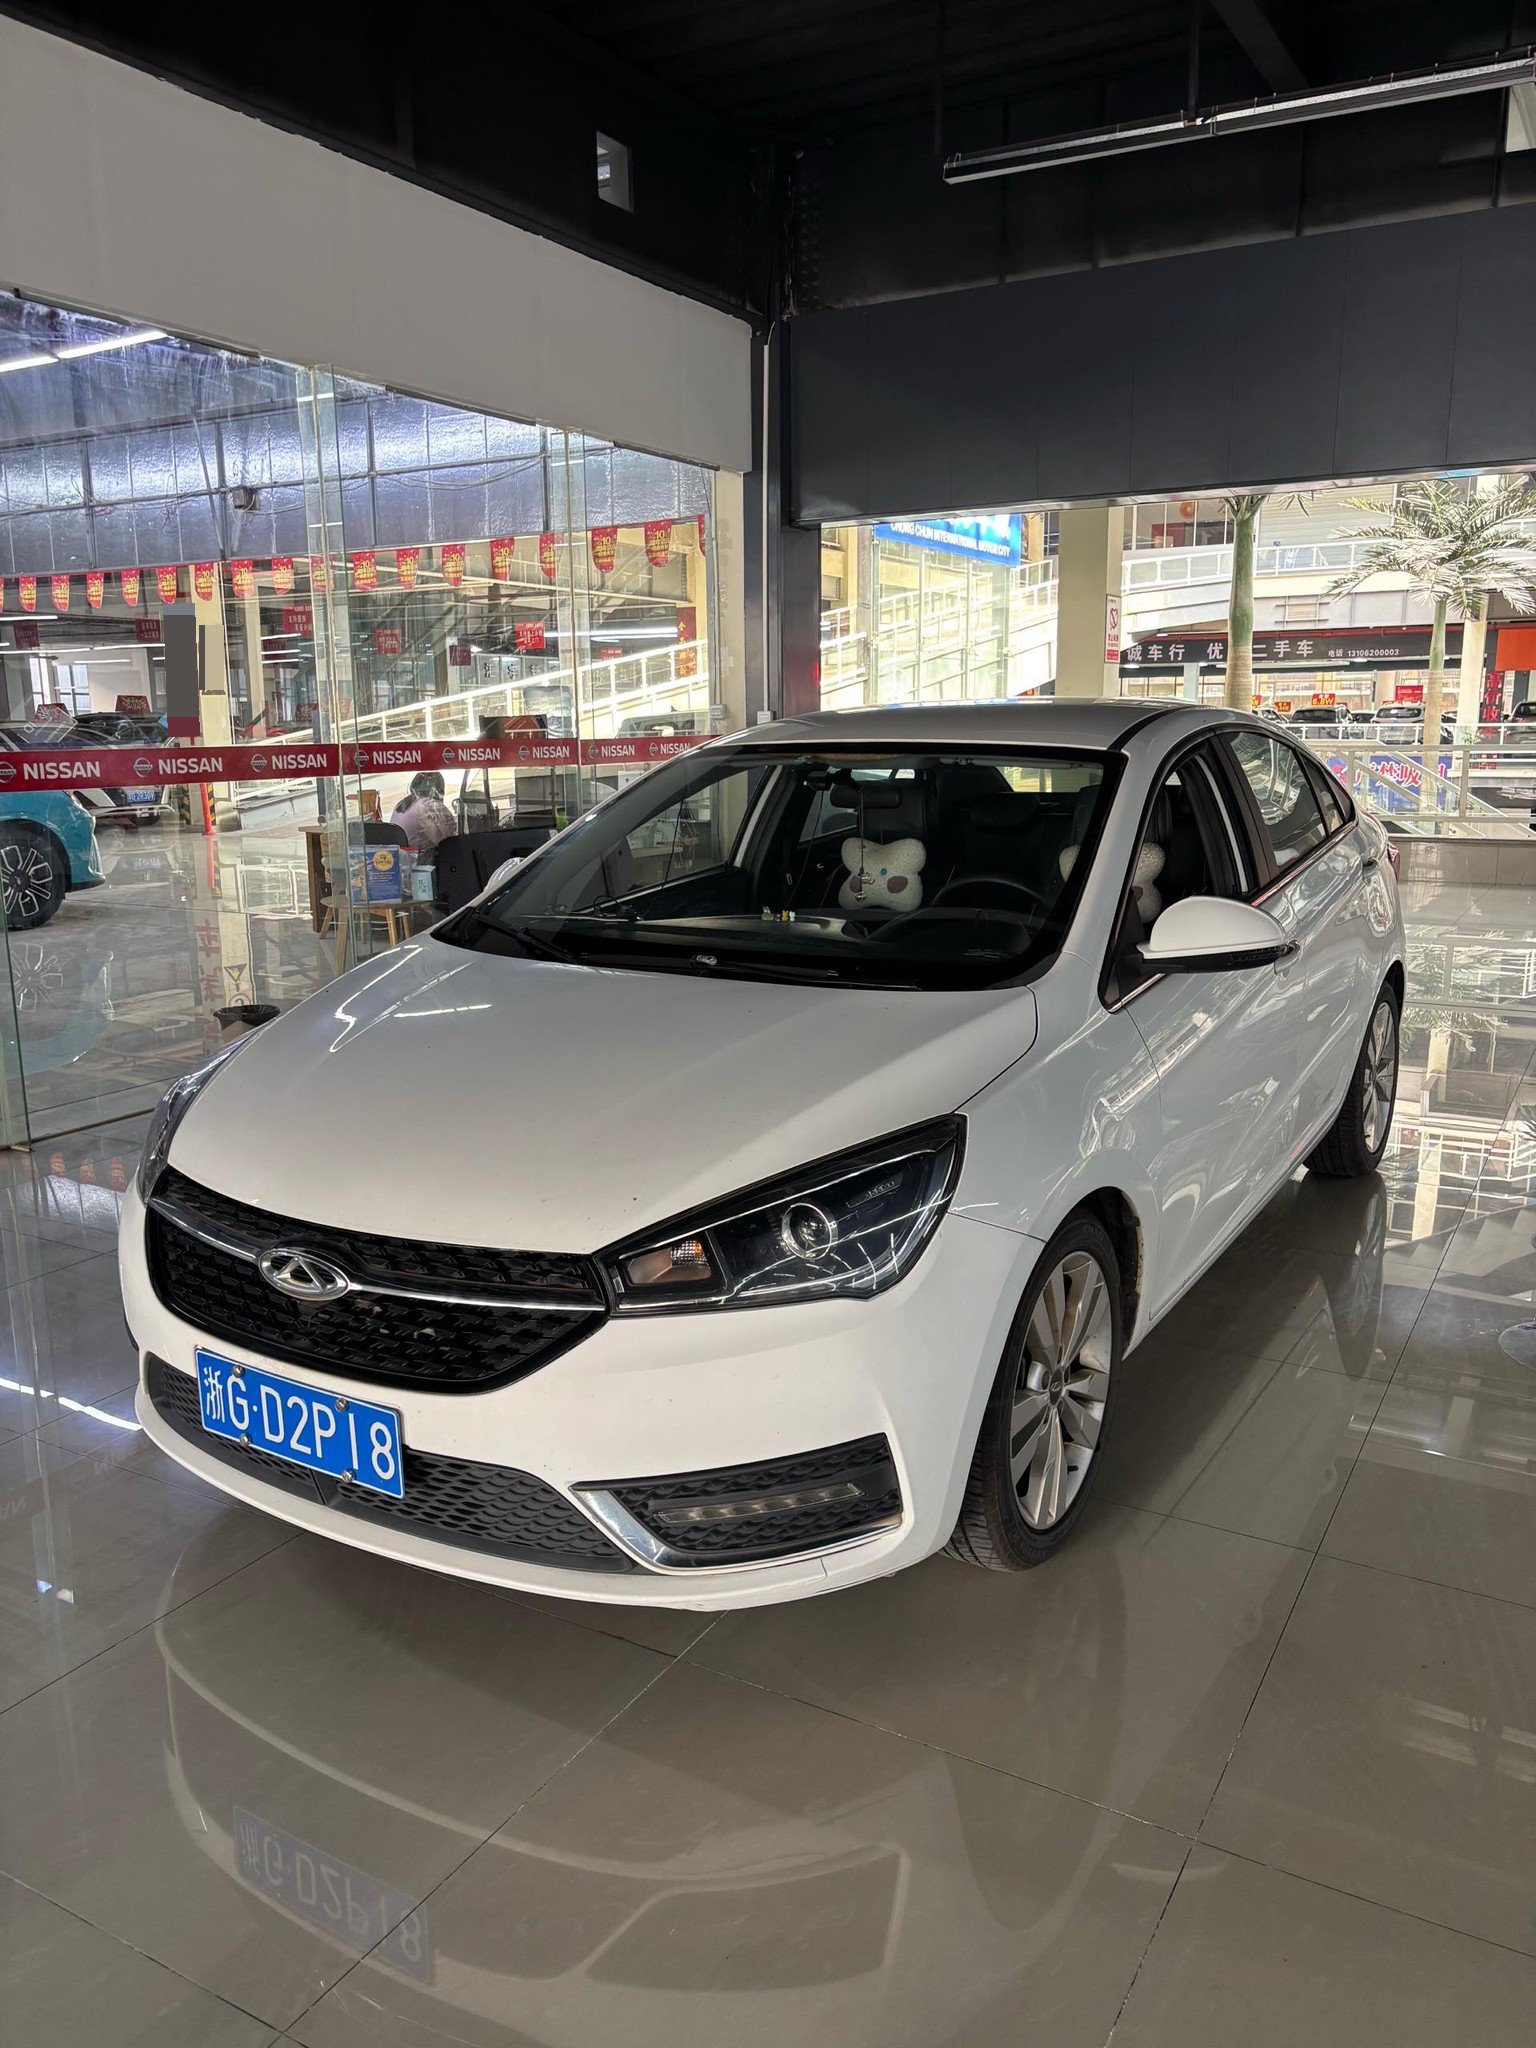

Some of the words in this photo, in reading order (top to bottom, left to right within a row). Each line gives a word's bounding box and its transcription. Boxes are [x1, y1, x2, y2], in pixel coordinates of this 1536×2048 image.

[1126, 643, 1185, 661] 诚车行
[1347, 648, 1400, 657] 13106200003
[373, 750, 421, 765] NISSAN
[458, 747, 500, 761] NISSAN
[532, 746, 570, 759] NISSAN
[601, 744, 635, 757] NISSAN
[158, 756, 223, 775] NISSAN
[272, 753, 327, 770] NISSAN
[23, 761, 100, 780] NISSAN
[203, 1366, 396, 1480] 浙G·D2P18
